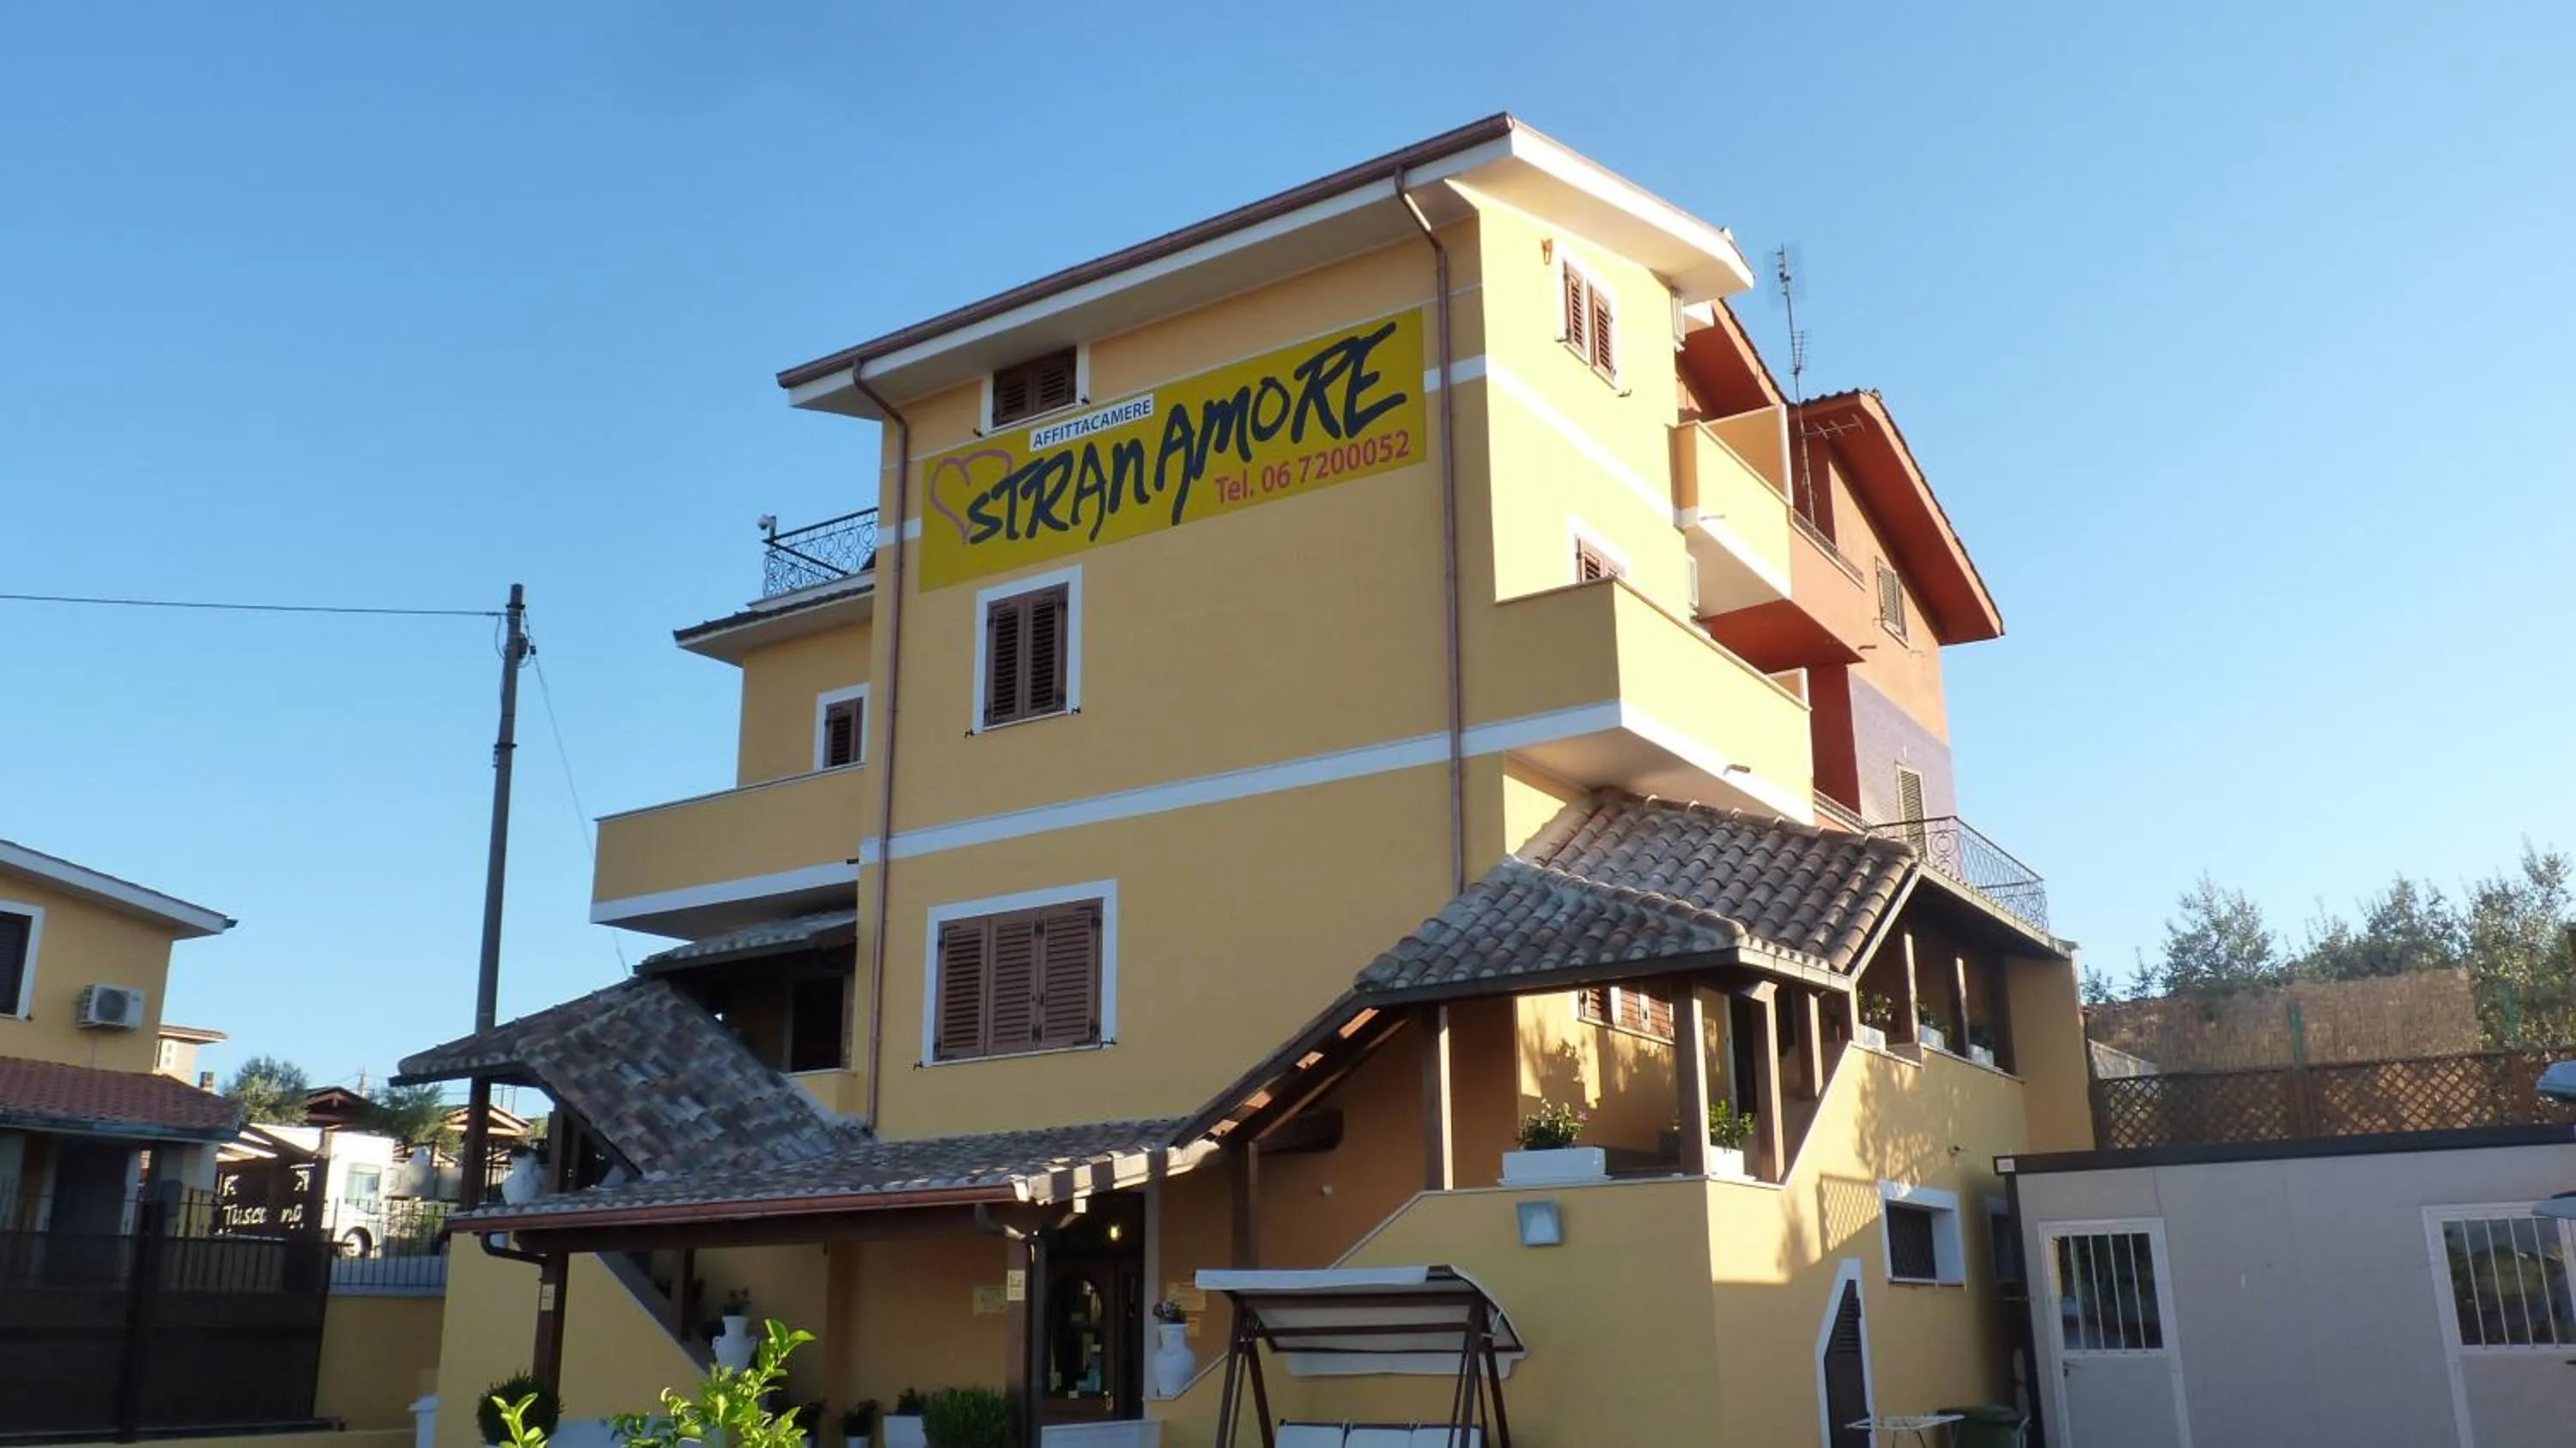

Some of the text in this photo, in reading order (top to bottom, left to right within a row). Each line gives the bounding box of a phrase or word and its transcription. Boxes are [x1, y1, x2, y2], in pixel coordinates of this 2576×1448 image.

[965, 322, 1408, 545] STRANAMORE
[1033, 399, 1151, 447] AFFITTACAMERE
[1214, 429, 1410, 505] Tel. 06 7200052
